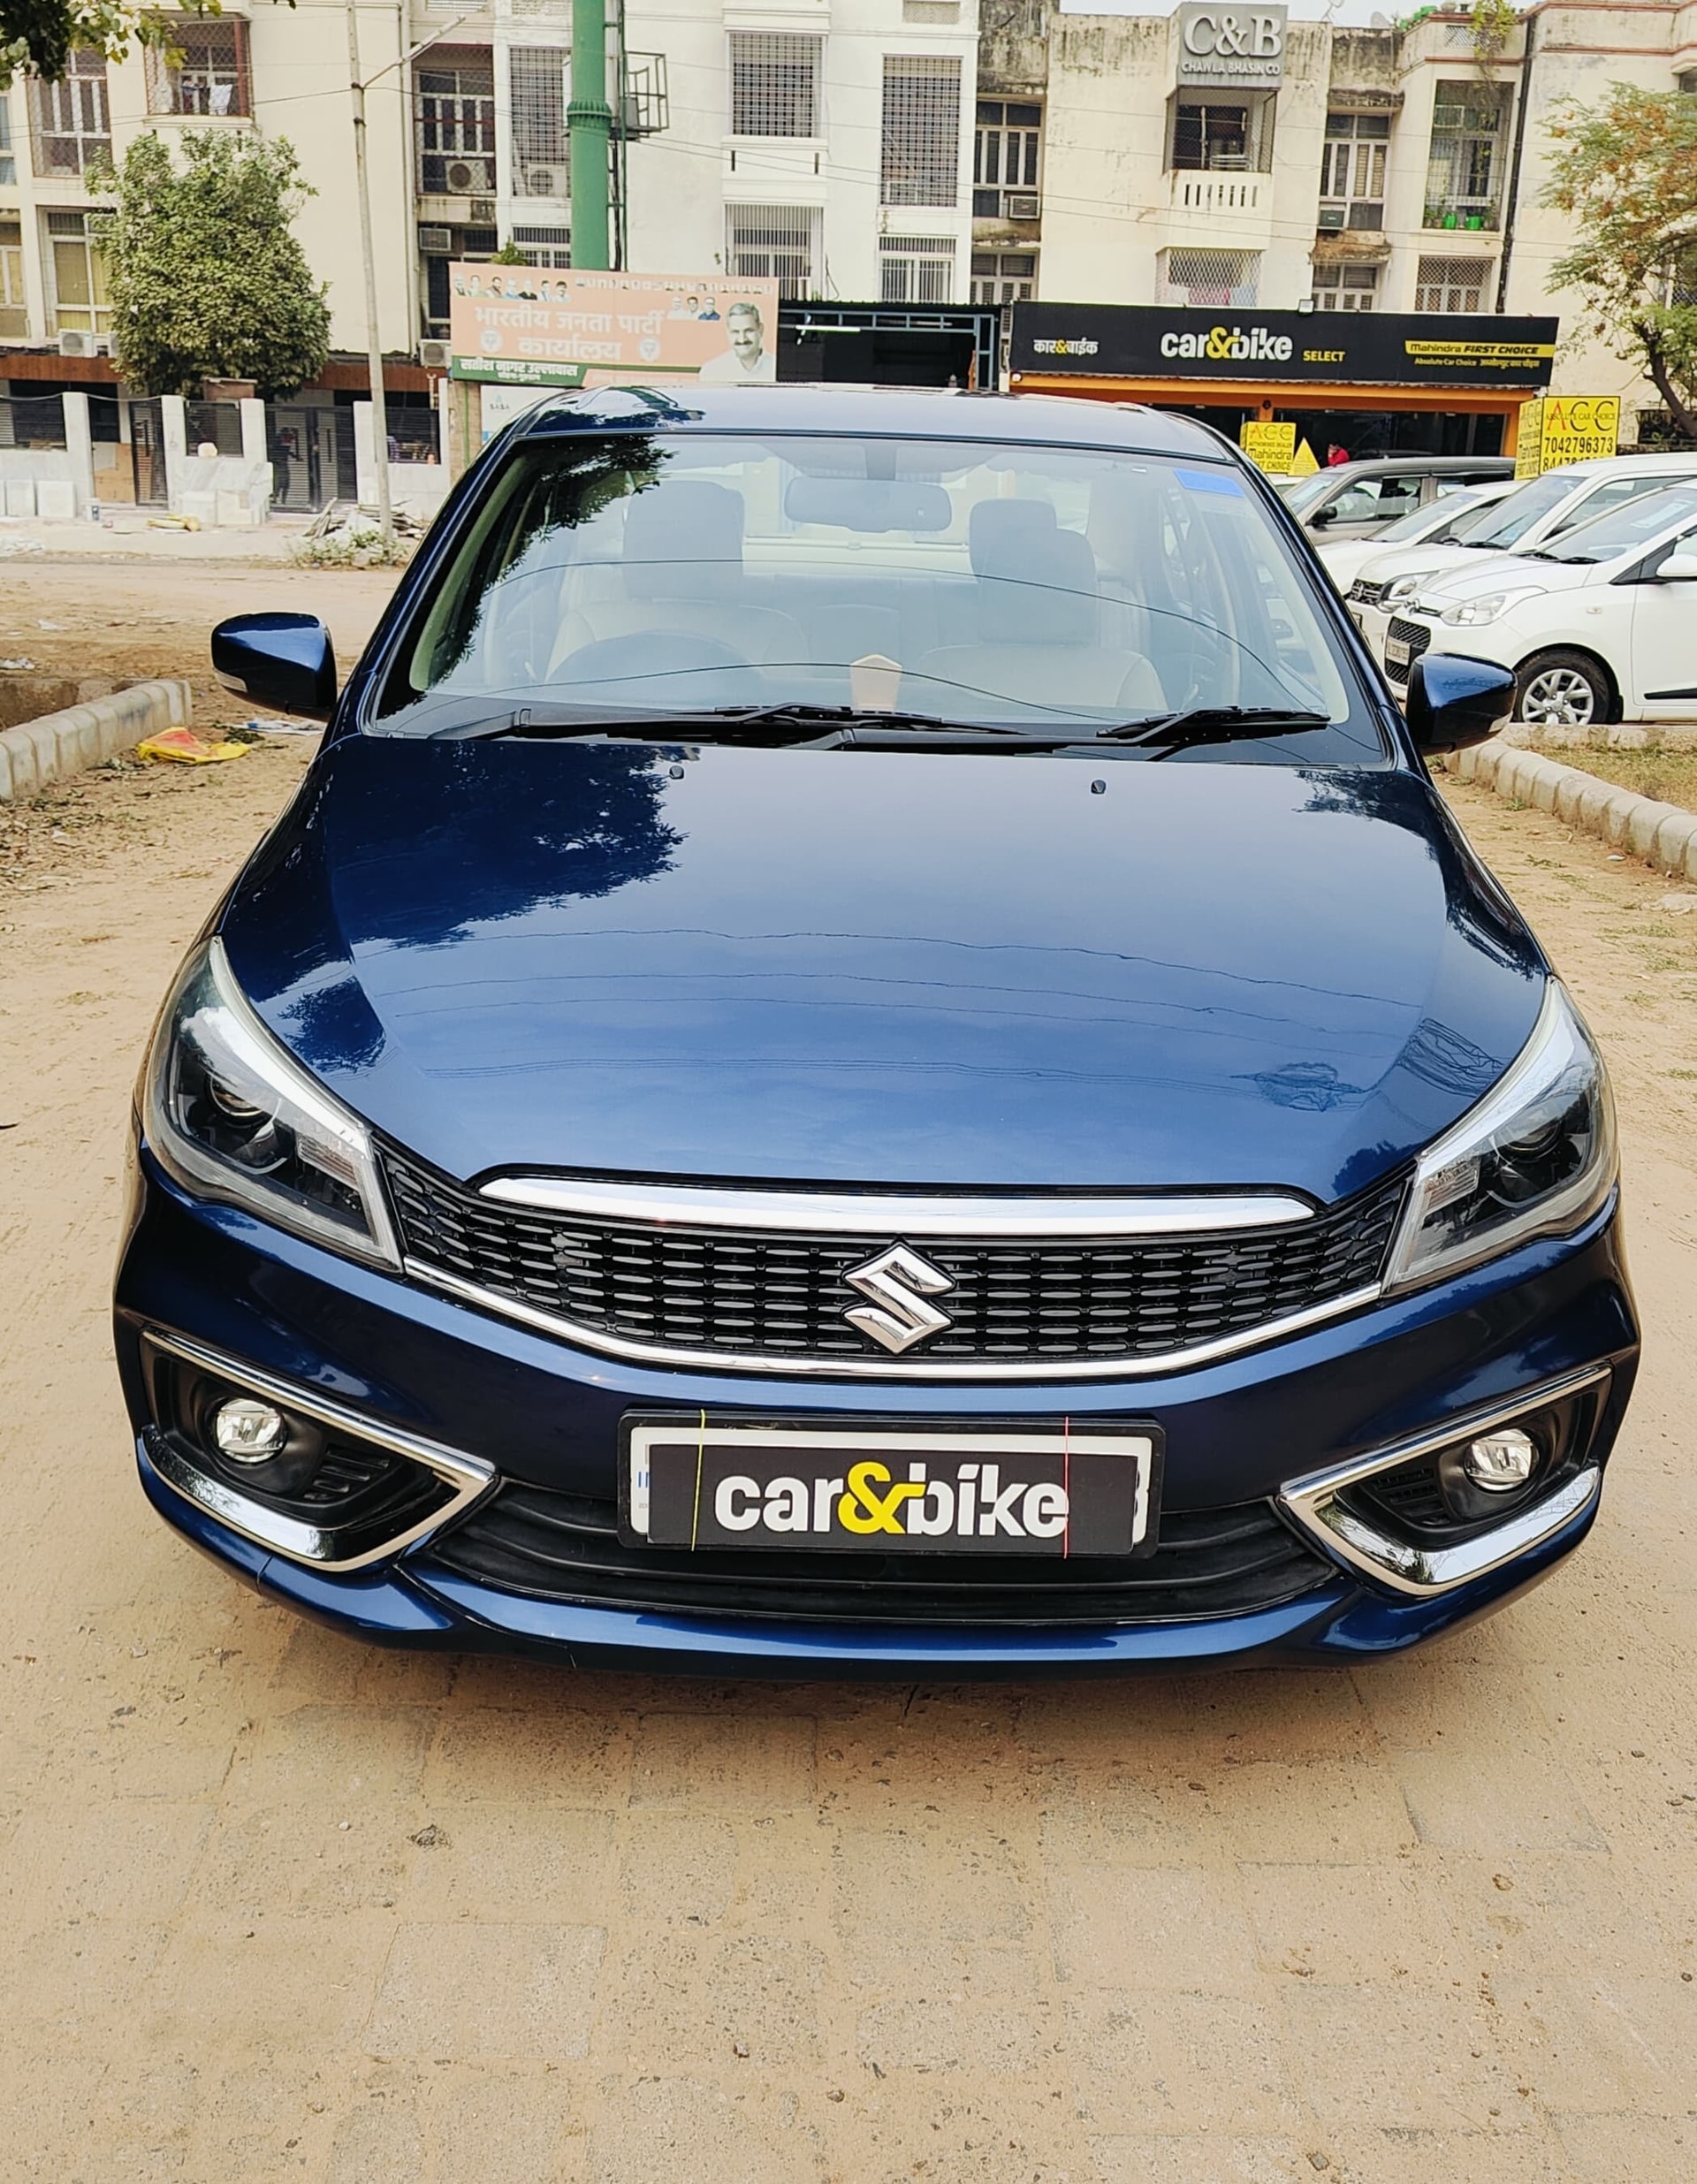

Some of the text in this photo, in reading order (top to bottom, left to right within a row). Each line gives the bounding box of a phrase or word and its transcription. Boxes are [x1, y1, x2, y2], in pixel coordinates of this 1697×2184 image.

[1183, 15, 1283, 57] C&B
[1181, 62, 1282, 75] CHAWLA BHASIN CO
[476, 303, 665, 335] भारतीय जनता पार्टी
[517, 333, 622, 361] कार्यालय
[1161, 326, 1345, 361] car&bike SELECT
[1410, 343, 1540, 355] Mahindra FIRST CHOICE
[1545, 400, 1616, 432] ACC
[1248, 447, 1292, 460] Mahindra
[1544, 437, 1614, 454] 7042796373
[714, 1460, 1069, 1538] car&bike
